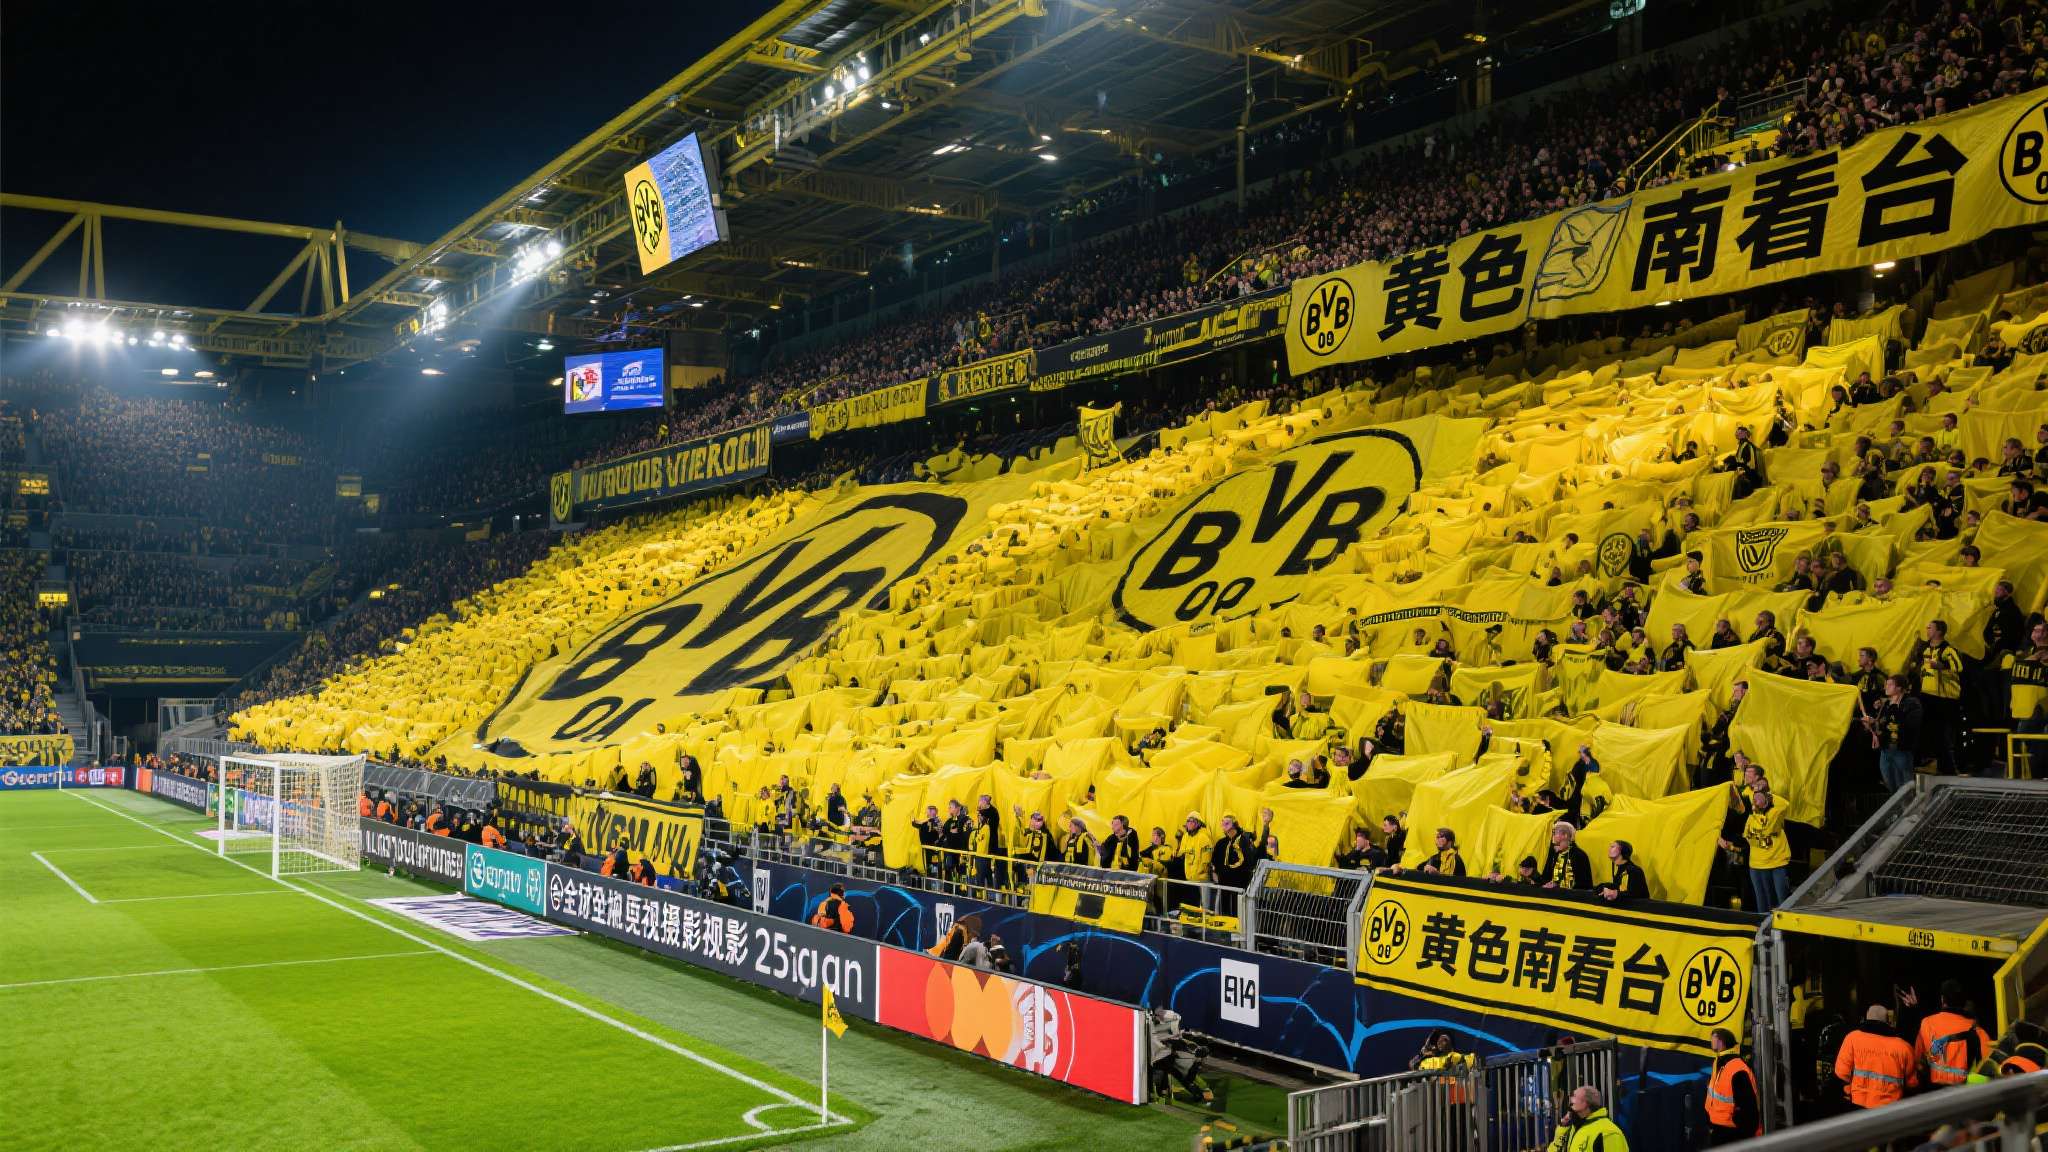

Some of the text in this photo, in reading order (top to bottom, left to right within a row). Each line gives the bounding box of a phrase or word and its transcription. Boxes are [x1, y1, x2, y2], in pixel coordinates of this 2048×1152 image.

[1377, 234, 1528, 342] 黄色
[1631, 131, 1968, 291] 南看台
[1306, 285, 1350, 336] BVB
[1140, 451, 1386, 590] BVB
[539, 523, 904, 701] BVB
[1369, 906, 1405, 946] BVB
[1416, 912, 1670, 1015] 黄色南看台
[1685, 956, 1735, 1003] BVB
